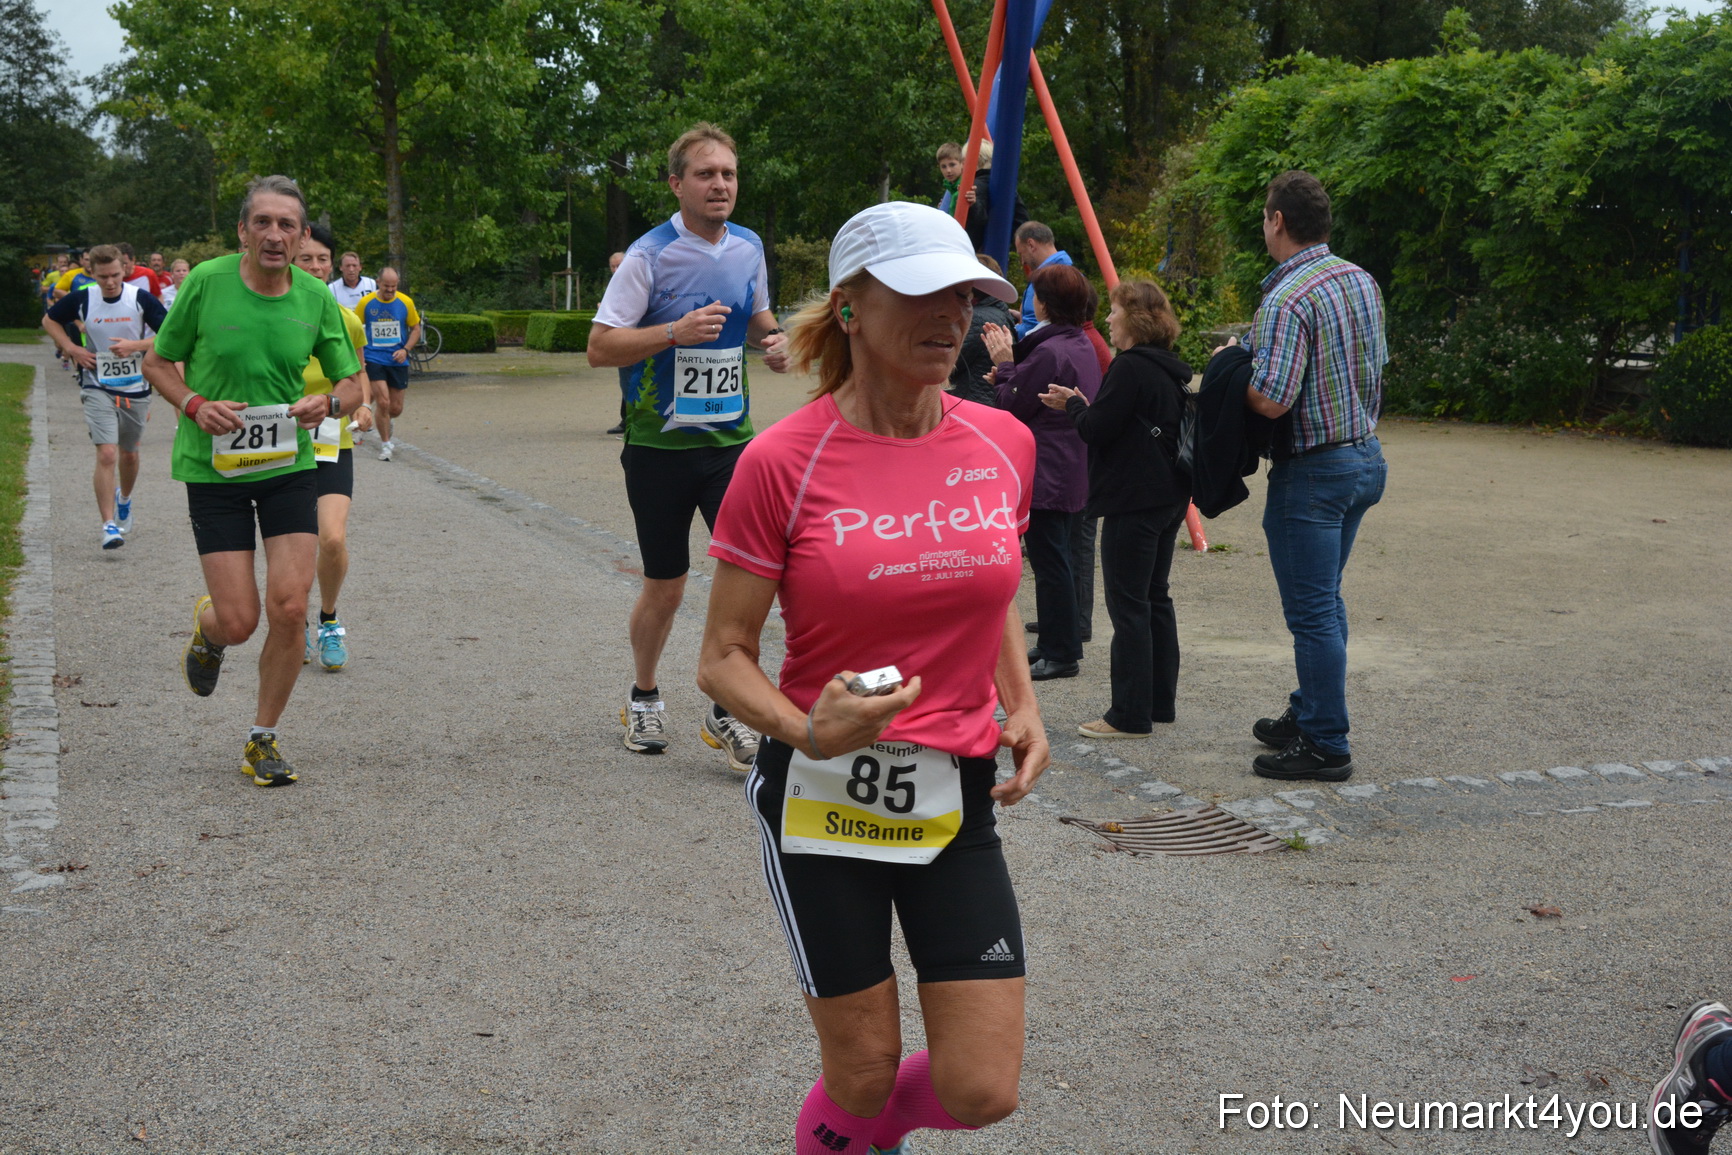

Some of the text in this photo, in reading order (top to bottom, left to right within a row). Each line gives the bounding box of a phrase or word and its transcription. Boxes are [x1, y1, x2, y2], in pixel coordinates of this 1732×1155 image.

[374, 327, 398, 338] 3424
[677, 356, 736, 364] PARTL Neumarkt
[102, 359, 137, 377] 2551
[683, 366, 739, 394] 2125
[704, 401, 723, 414] Sigi
[245, 412, 283, 421] Neumarkt
[230, 422, 278, 450] 281
[236, 457, 273, 467] Jürge
[823, 491, 1016, 546] Perfekt
[919, 549, 967, 560] nürnberger
[919, 554, 1012, 571] FRAUENLAUF
[935, 572, 953, 580] JULI
[954, 570, 974, 578] 2012
[792, 785, 801, 796] D
[846, 755, 918, 814] 85
[824, 811, 924, 842] Susanne
[980, 953, 1015, 962] adidas
